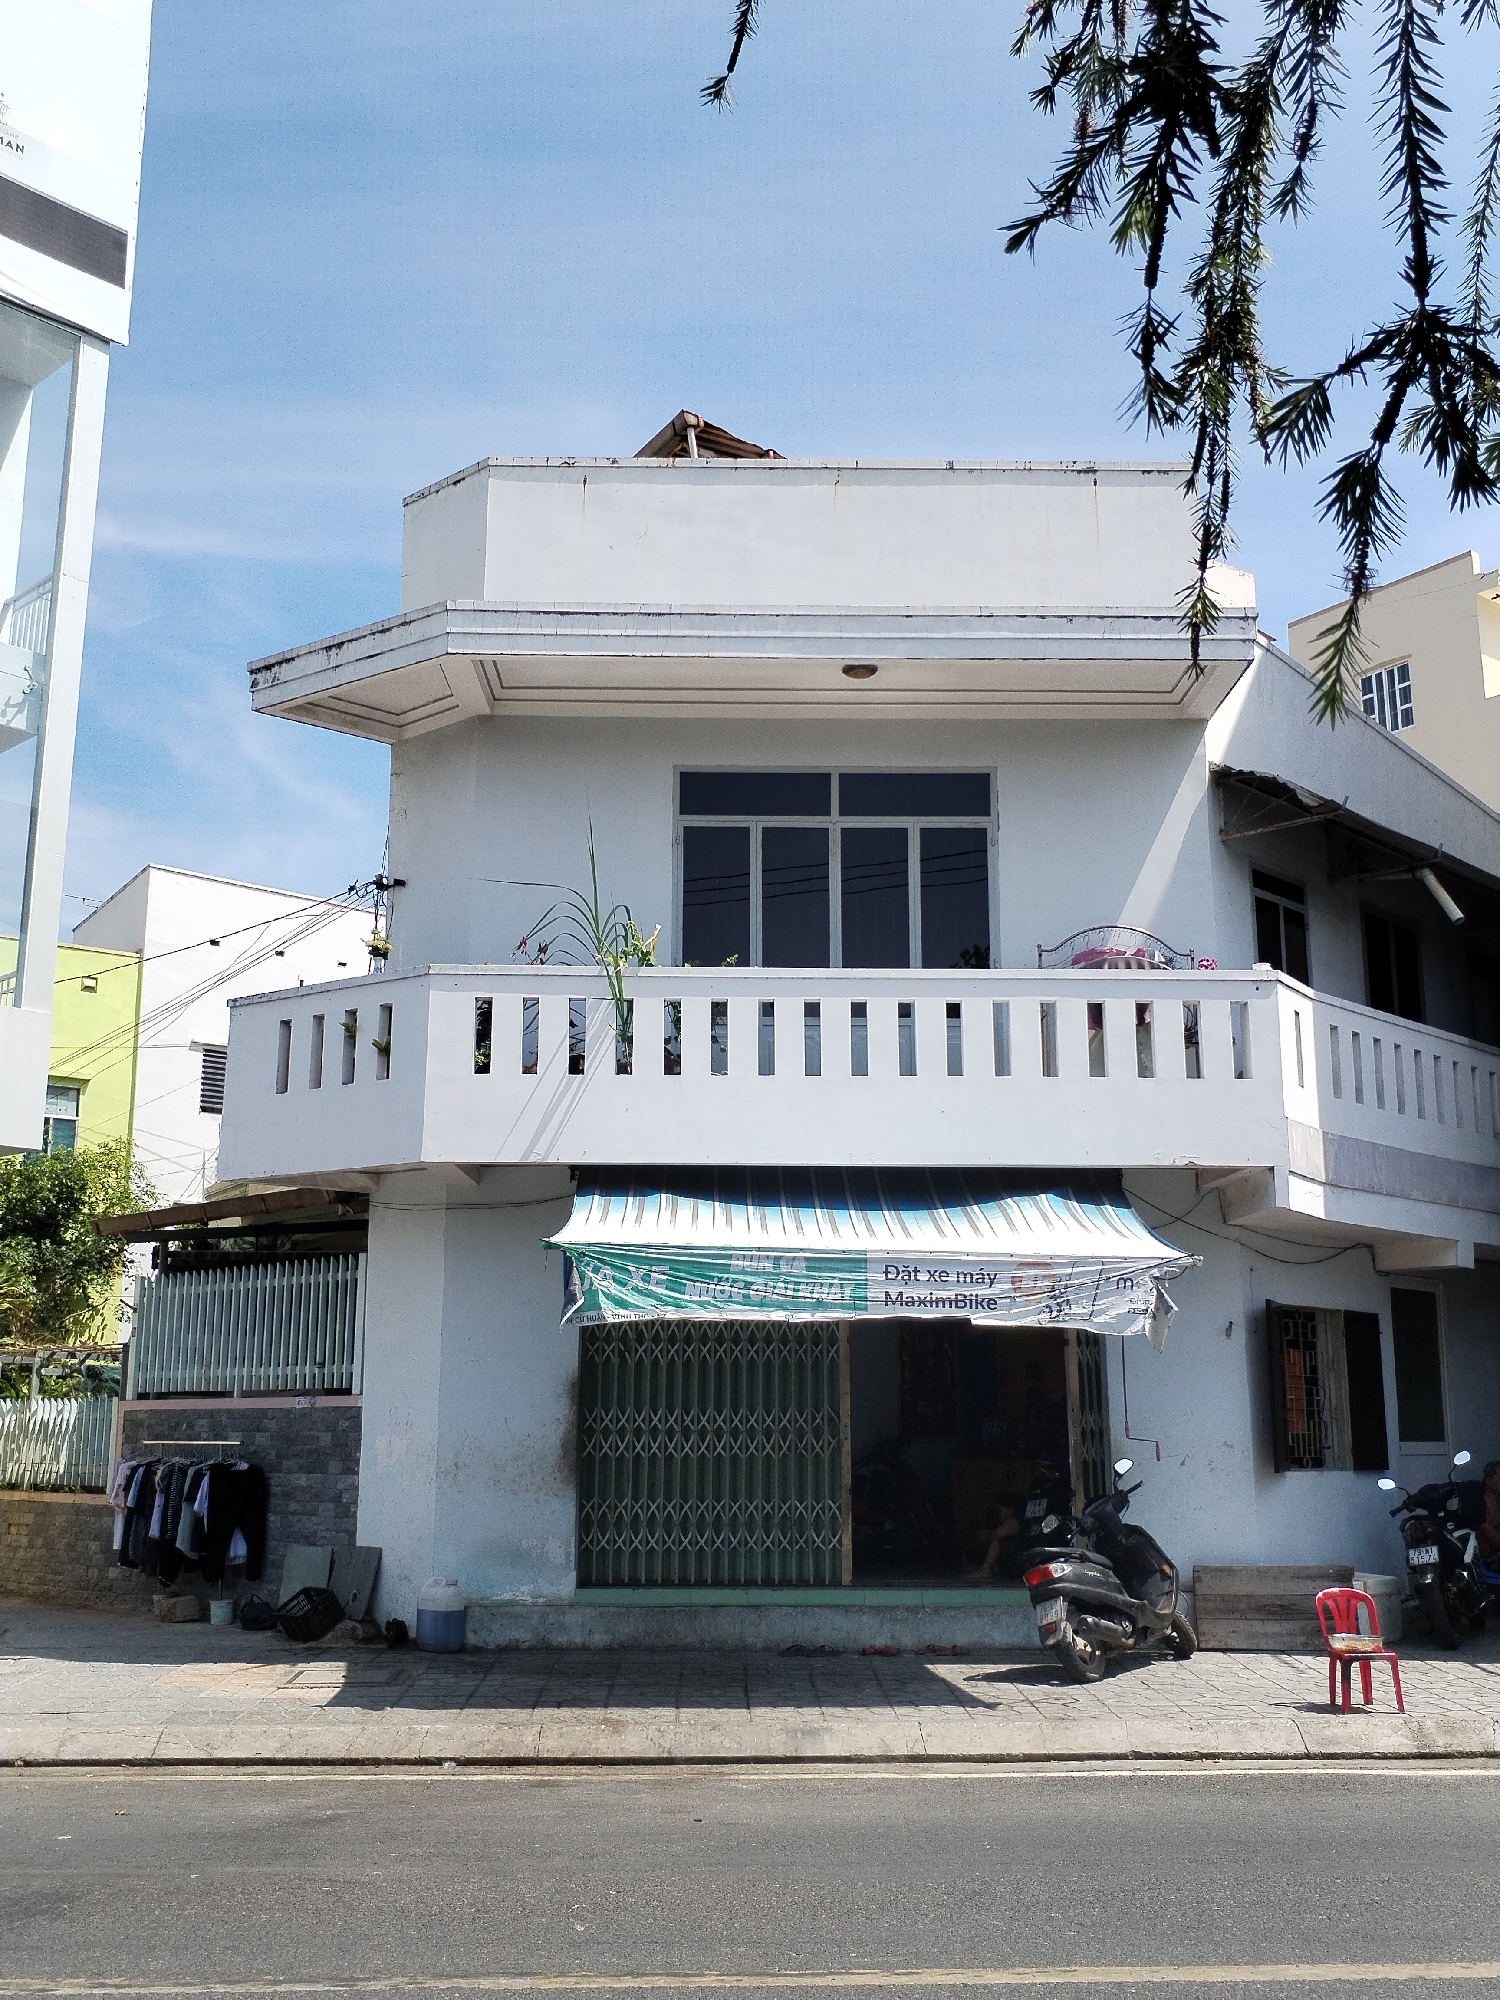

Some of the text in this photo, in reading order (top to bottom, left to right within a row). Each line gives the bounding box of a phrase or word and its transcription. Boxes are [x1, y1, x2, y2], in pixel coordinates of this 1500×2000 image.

[883, 1264, 998, 1288] Đặt xe máy
[884, 1290, 998, 1310] MaximBike
